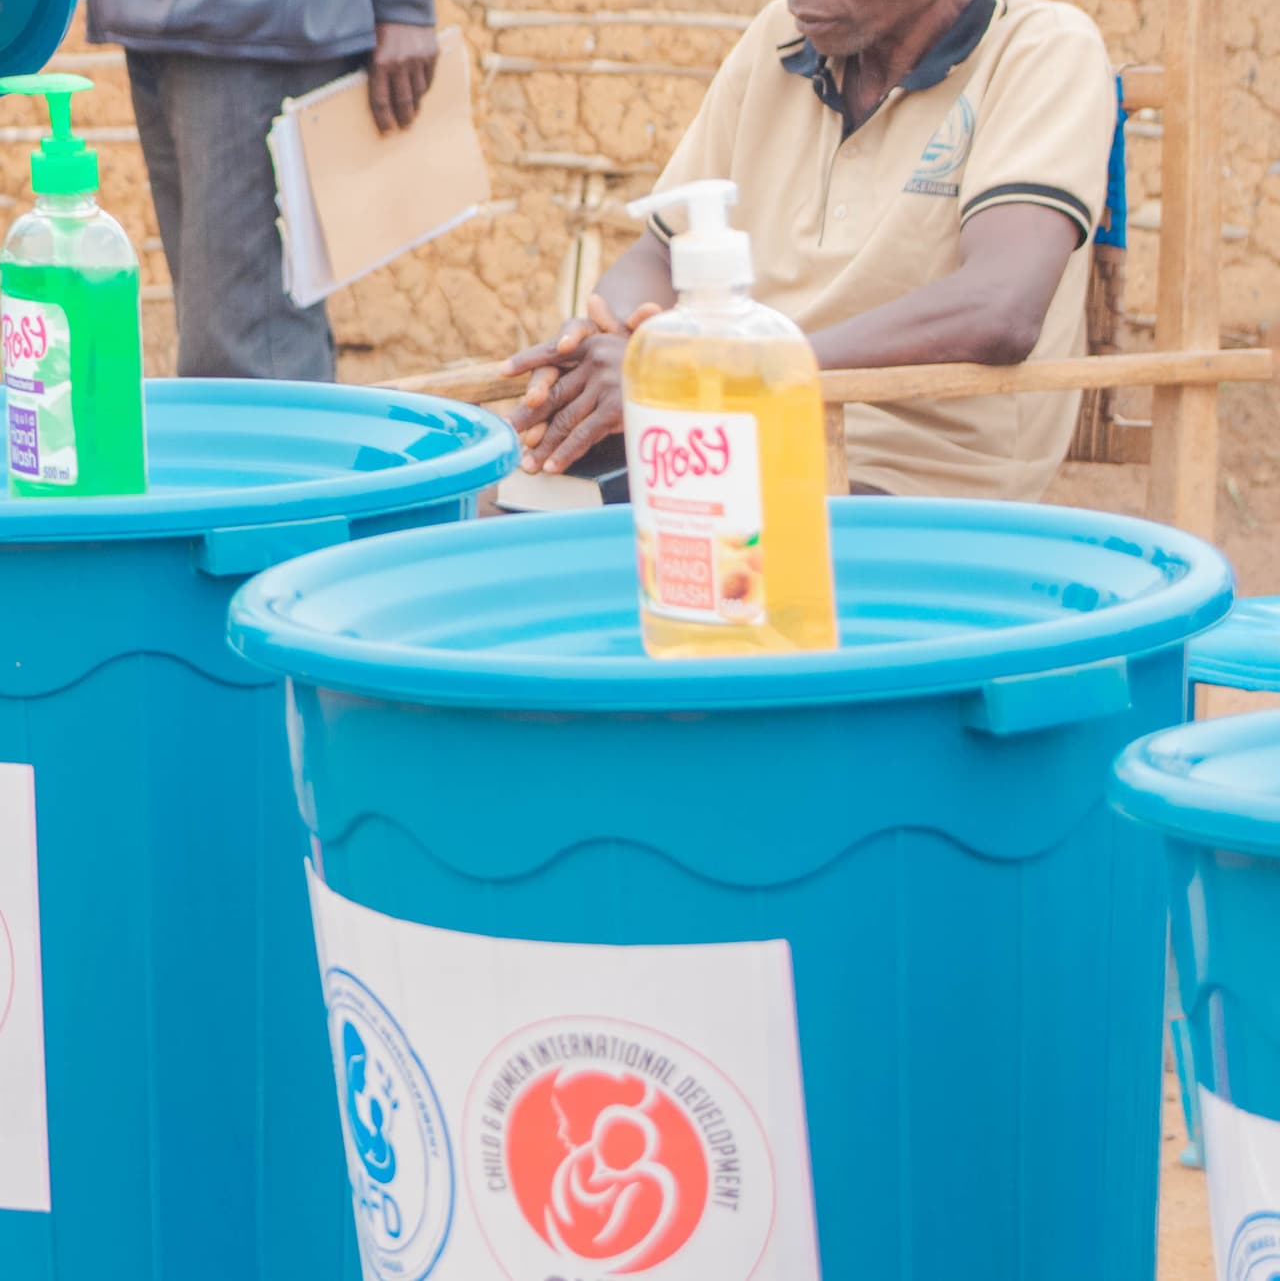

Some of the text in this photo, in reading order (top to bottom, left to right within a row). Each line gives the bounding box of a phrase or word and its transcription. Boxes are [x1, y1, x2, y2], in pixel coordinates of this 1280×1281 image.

[480, 1032, 741, 1212] CHILD & WOMEN INTERNATIONAL DEVELOPMENT
